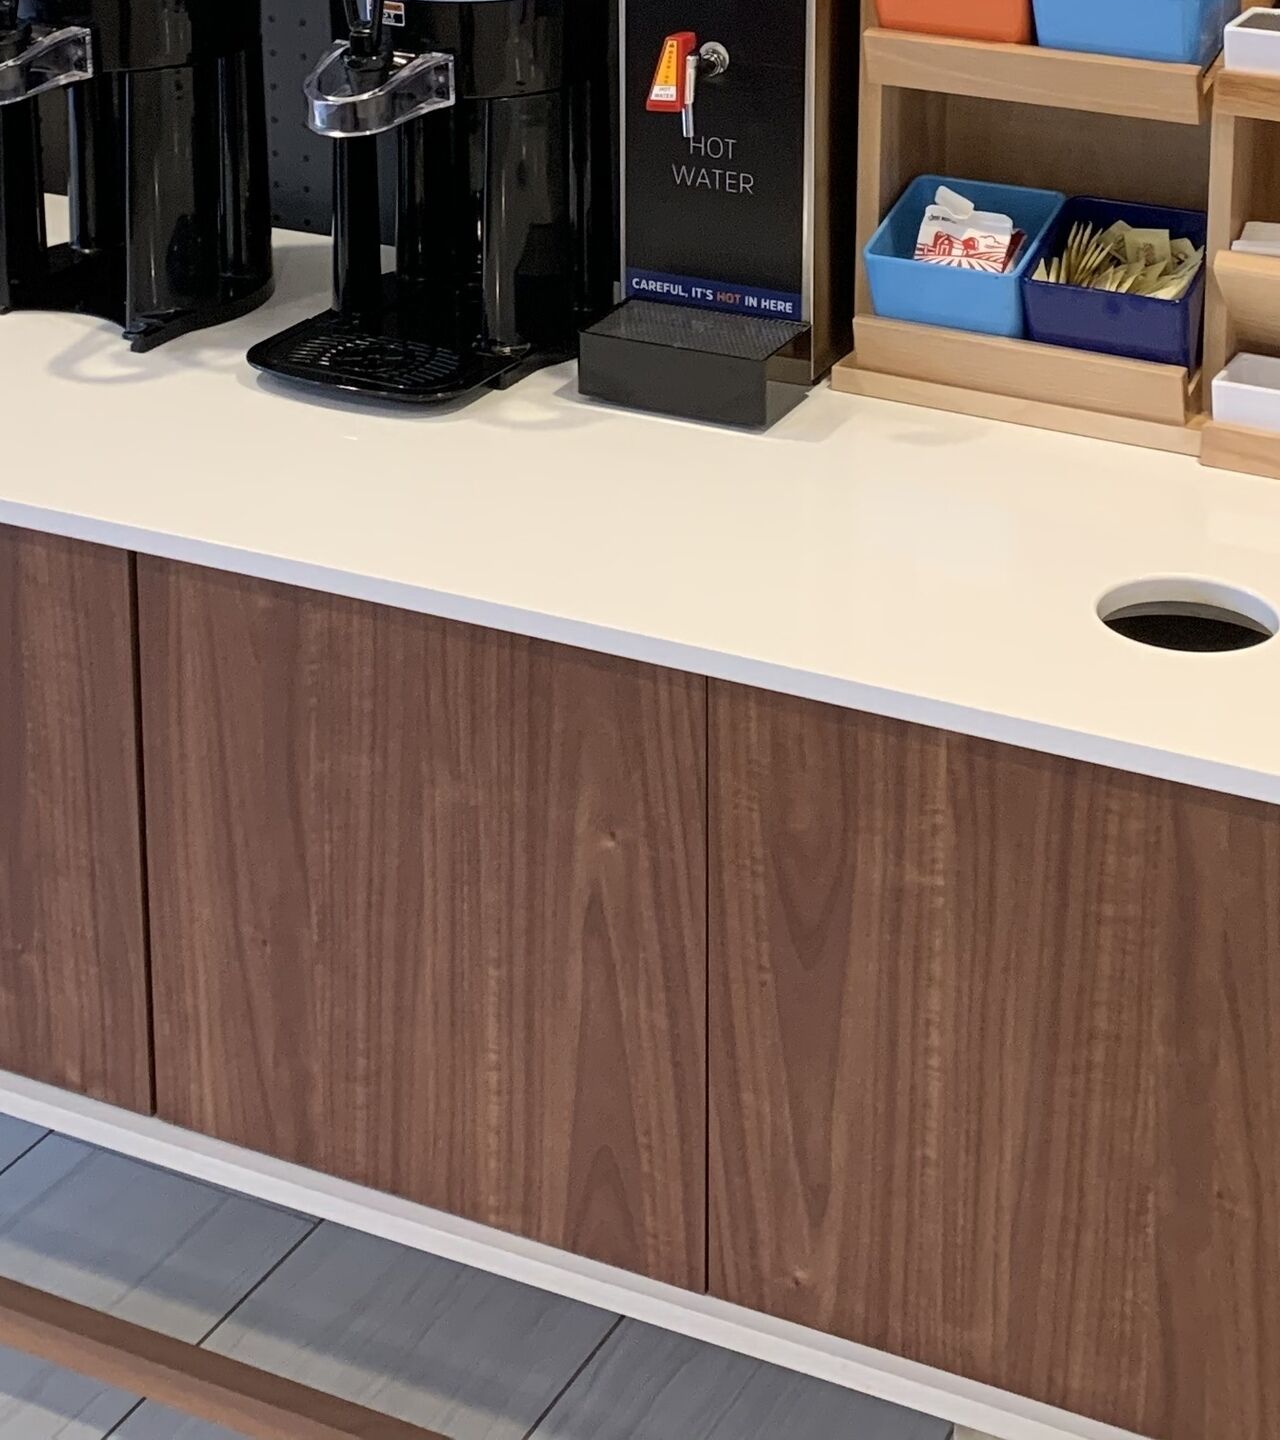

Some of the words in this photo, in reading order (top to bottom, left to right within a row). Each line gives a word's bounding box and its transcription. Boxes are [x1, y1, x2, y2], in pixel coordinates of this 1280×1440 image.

[689, 135, 738, 160] HOT
[671, 163, 755, 195] WATER
[631, 277, 689, 298] CAREFUL,
[691, 287, 714, 301] IT'S
[716, 291, 742, 305] HOT
[744, 295, 758, 308] IN
[760, 299, 793, 314] HERE
